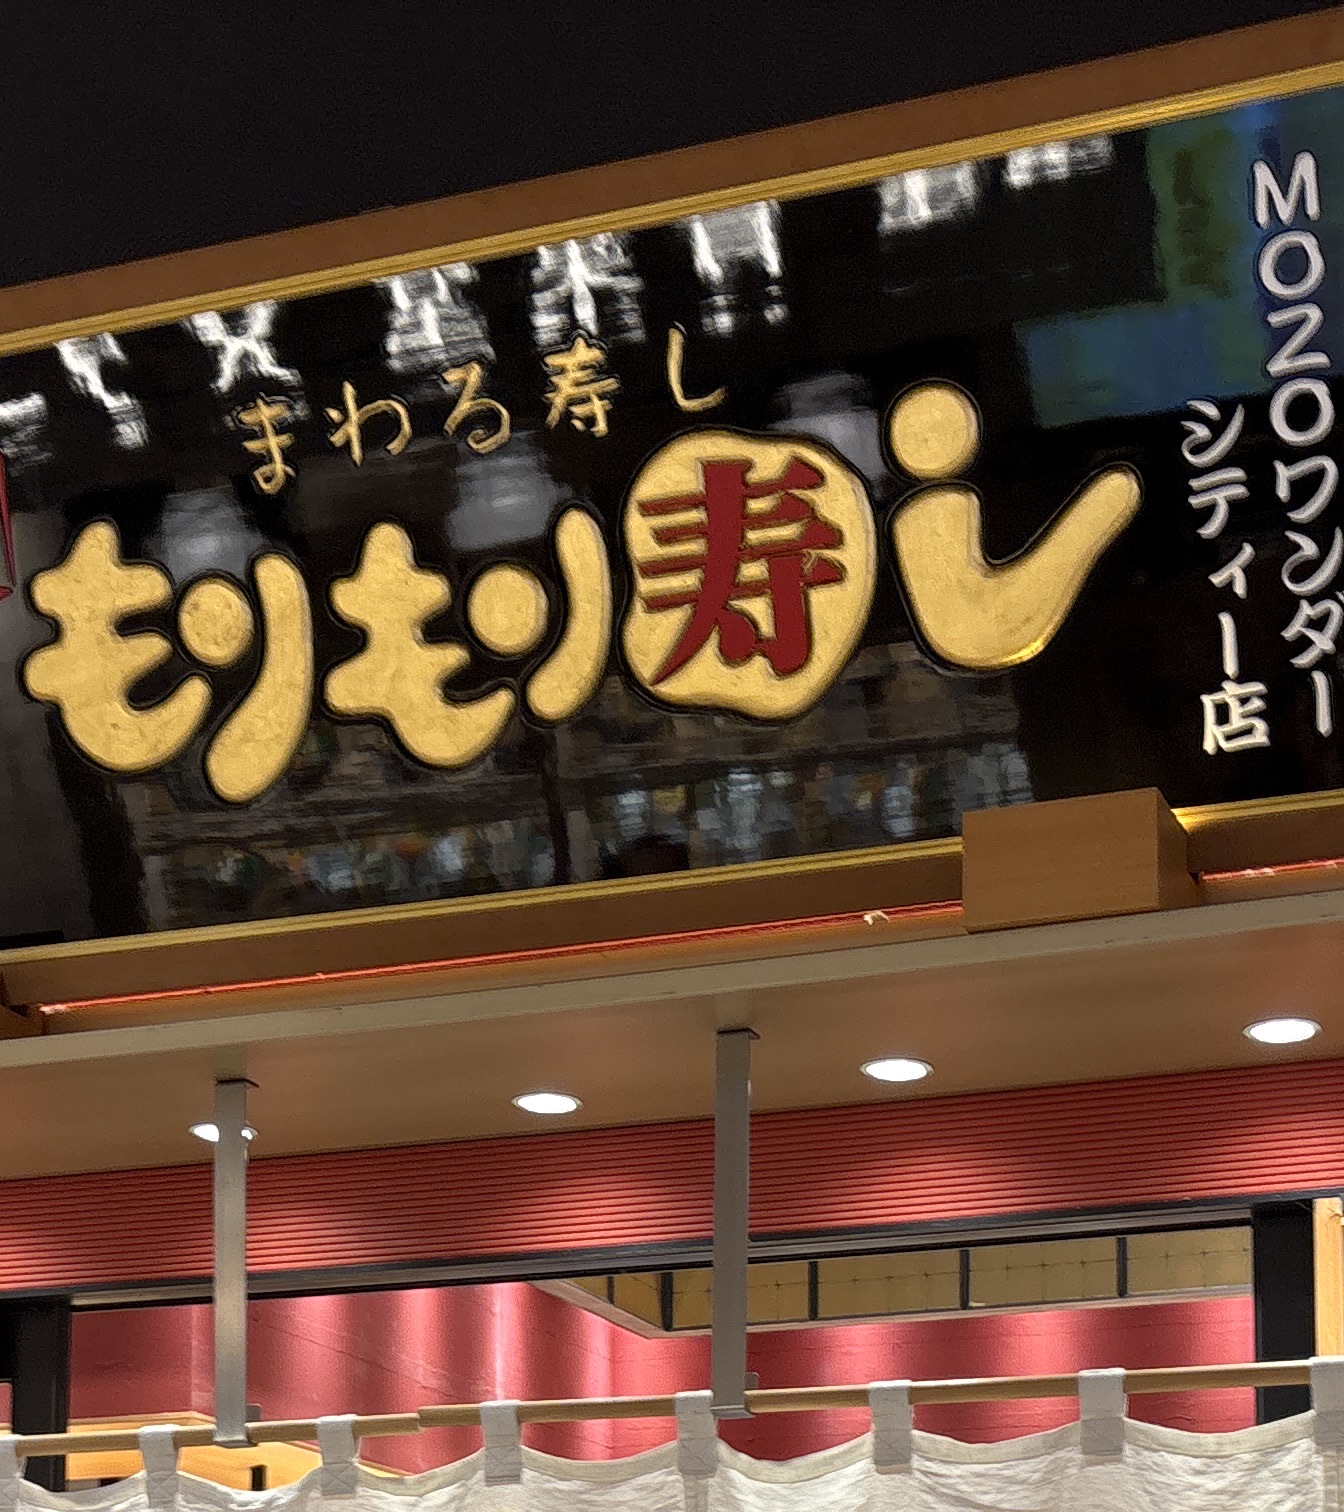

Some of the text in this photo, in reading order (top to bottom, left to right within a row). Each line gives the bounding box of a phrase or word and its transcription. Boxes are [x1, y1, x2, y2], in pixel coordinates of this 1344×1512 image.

[234, 325, 727, 494] まわる寿し
[1180, 399, 1270, 756] シティー店
[23, 381, 1142, 802] もりもり寿し
